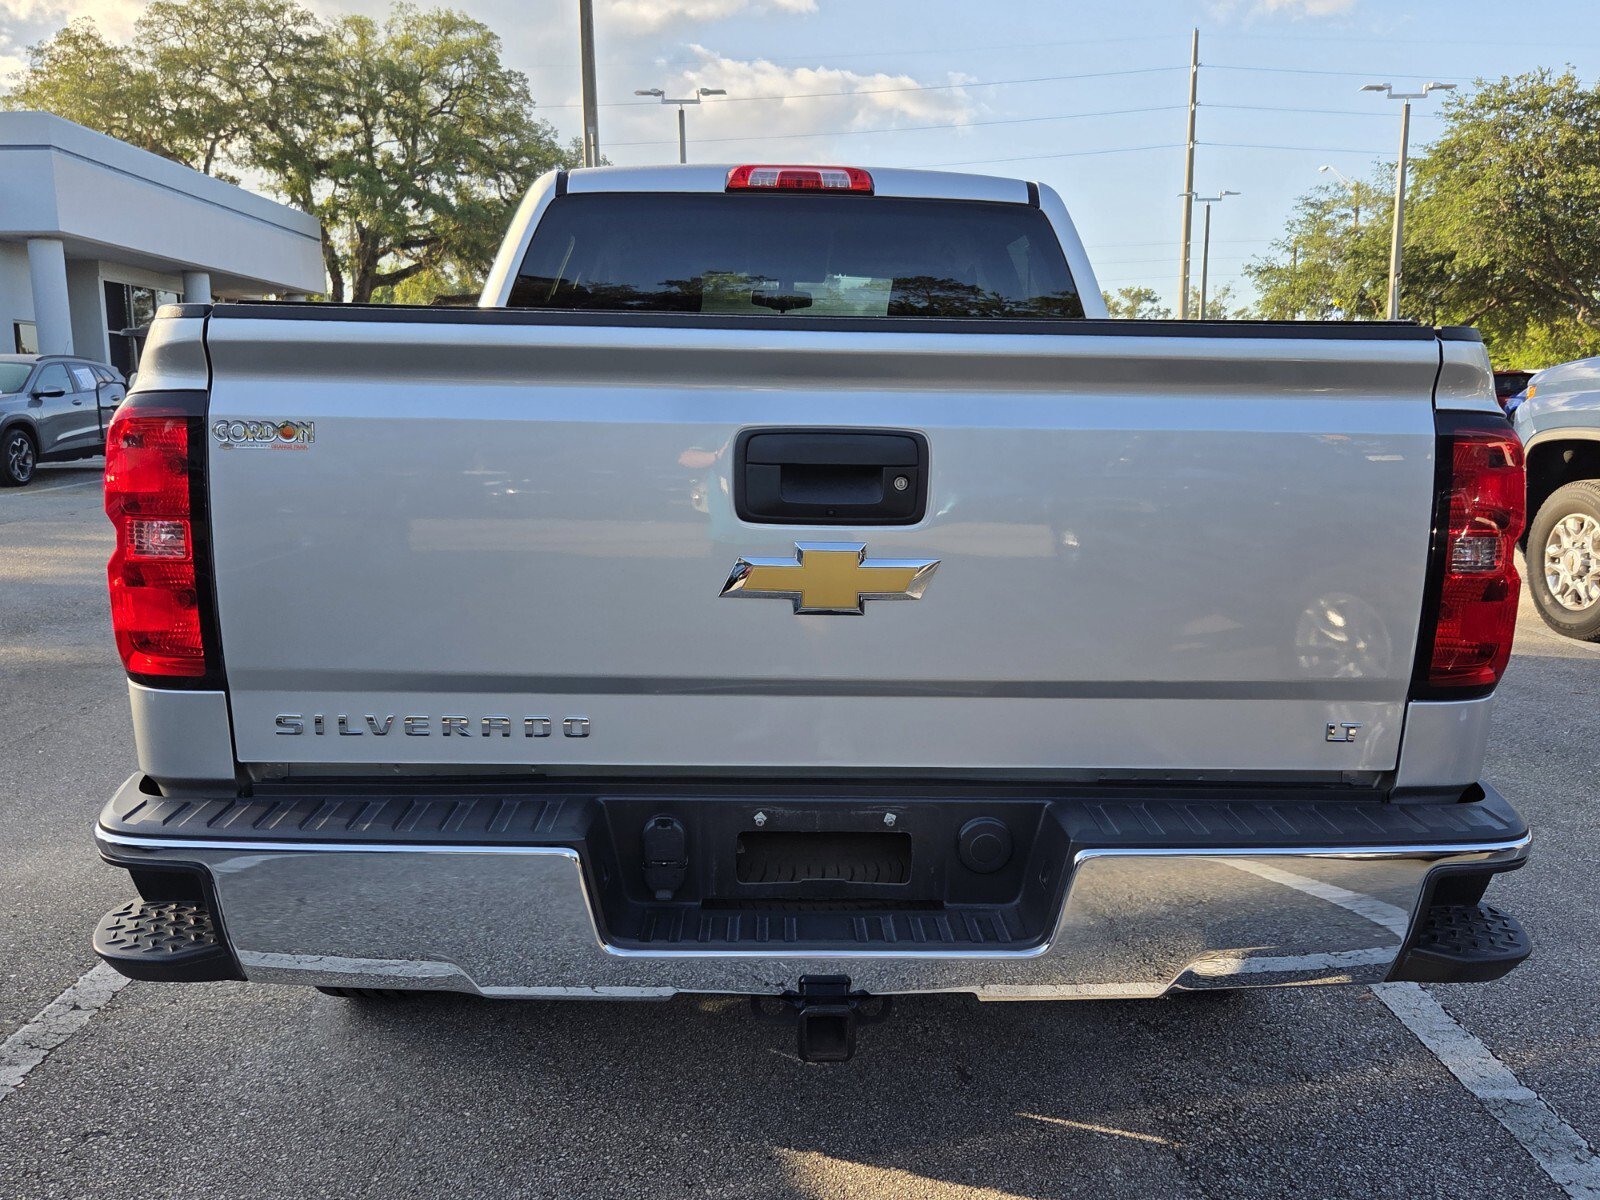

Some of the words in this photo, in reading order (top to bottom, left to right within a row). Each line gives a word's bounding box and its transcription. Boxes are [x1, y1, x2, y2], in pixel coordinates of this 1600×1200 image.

[212, 420, 315, 443] GORDON
[275, 713, 591, 738] SILVERADO
[1326, 722, 1361, 742] LT
